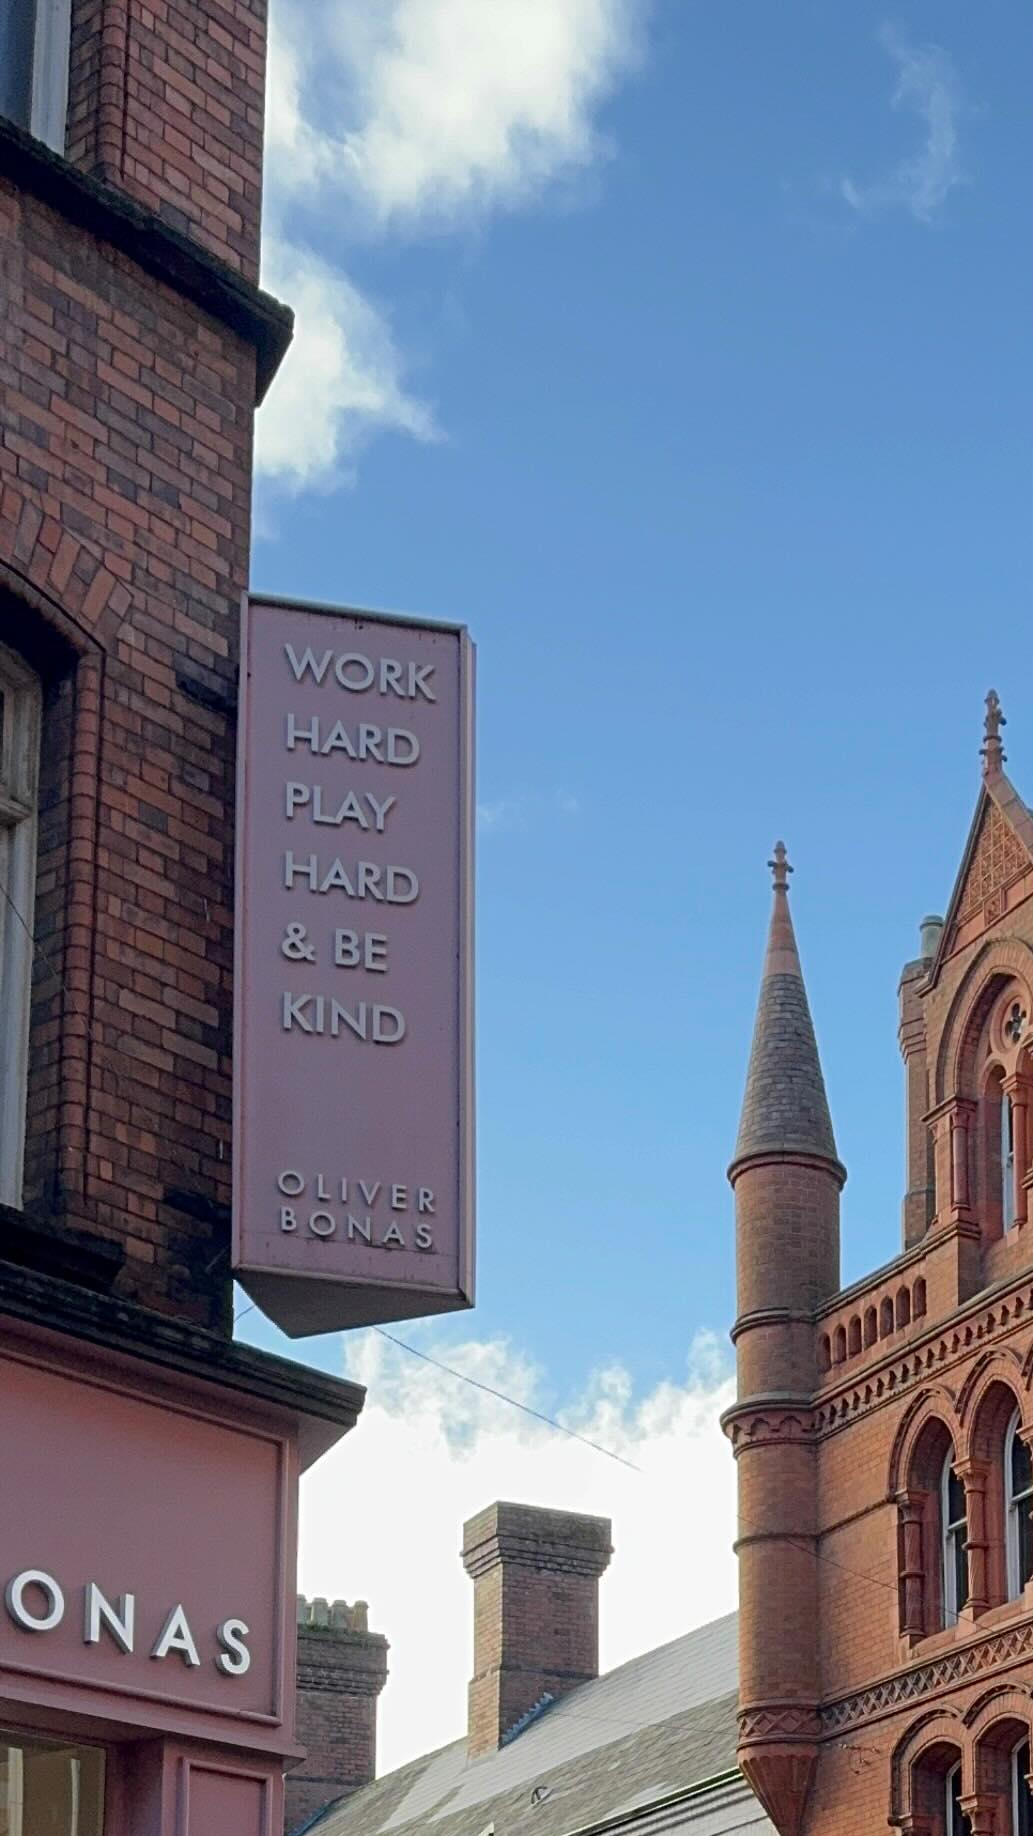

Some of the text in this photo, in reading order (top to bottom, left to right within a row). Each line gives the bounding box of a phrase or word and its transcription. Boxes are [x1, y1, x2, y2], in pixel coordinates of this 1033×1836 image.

[284, 643, 437, 701] WORK
[286, 713, 421, 766] HARD
[285, 782, 396, 831] PLAY
[284, 851, 420, 904] HARD
[281, 922, 389, 973] & BE
[282, 991, 407, 1045] KIND
[278, 1169, 436, 1213] OLIVER
[279, 1207, 434, 1250] BONAS
[5, 1569, 251, 1676] ONAS
